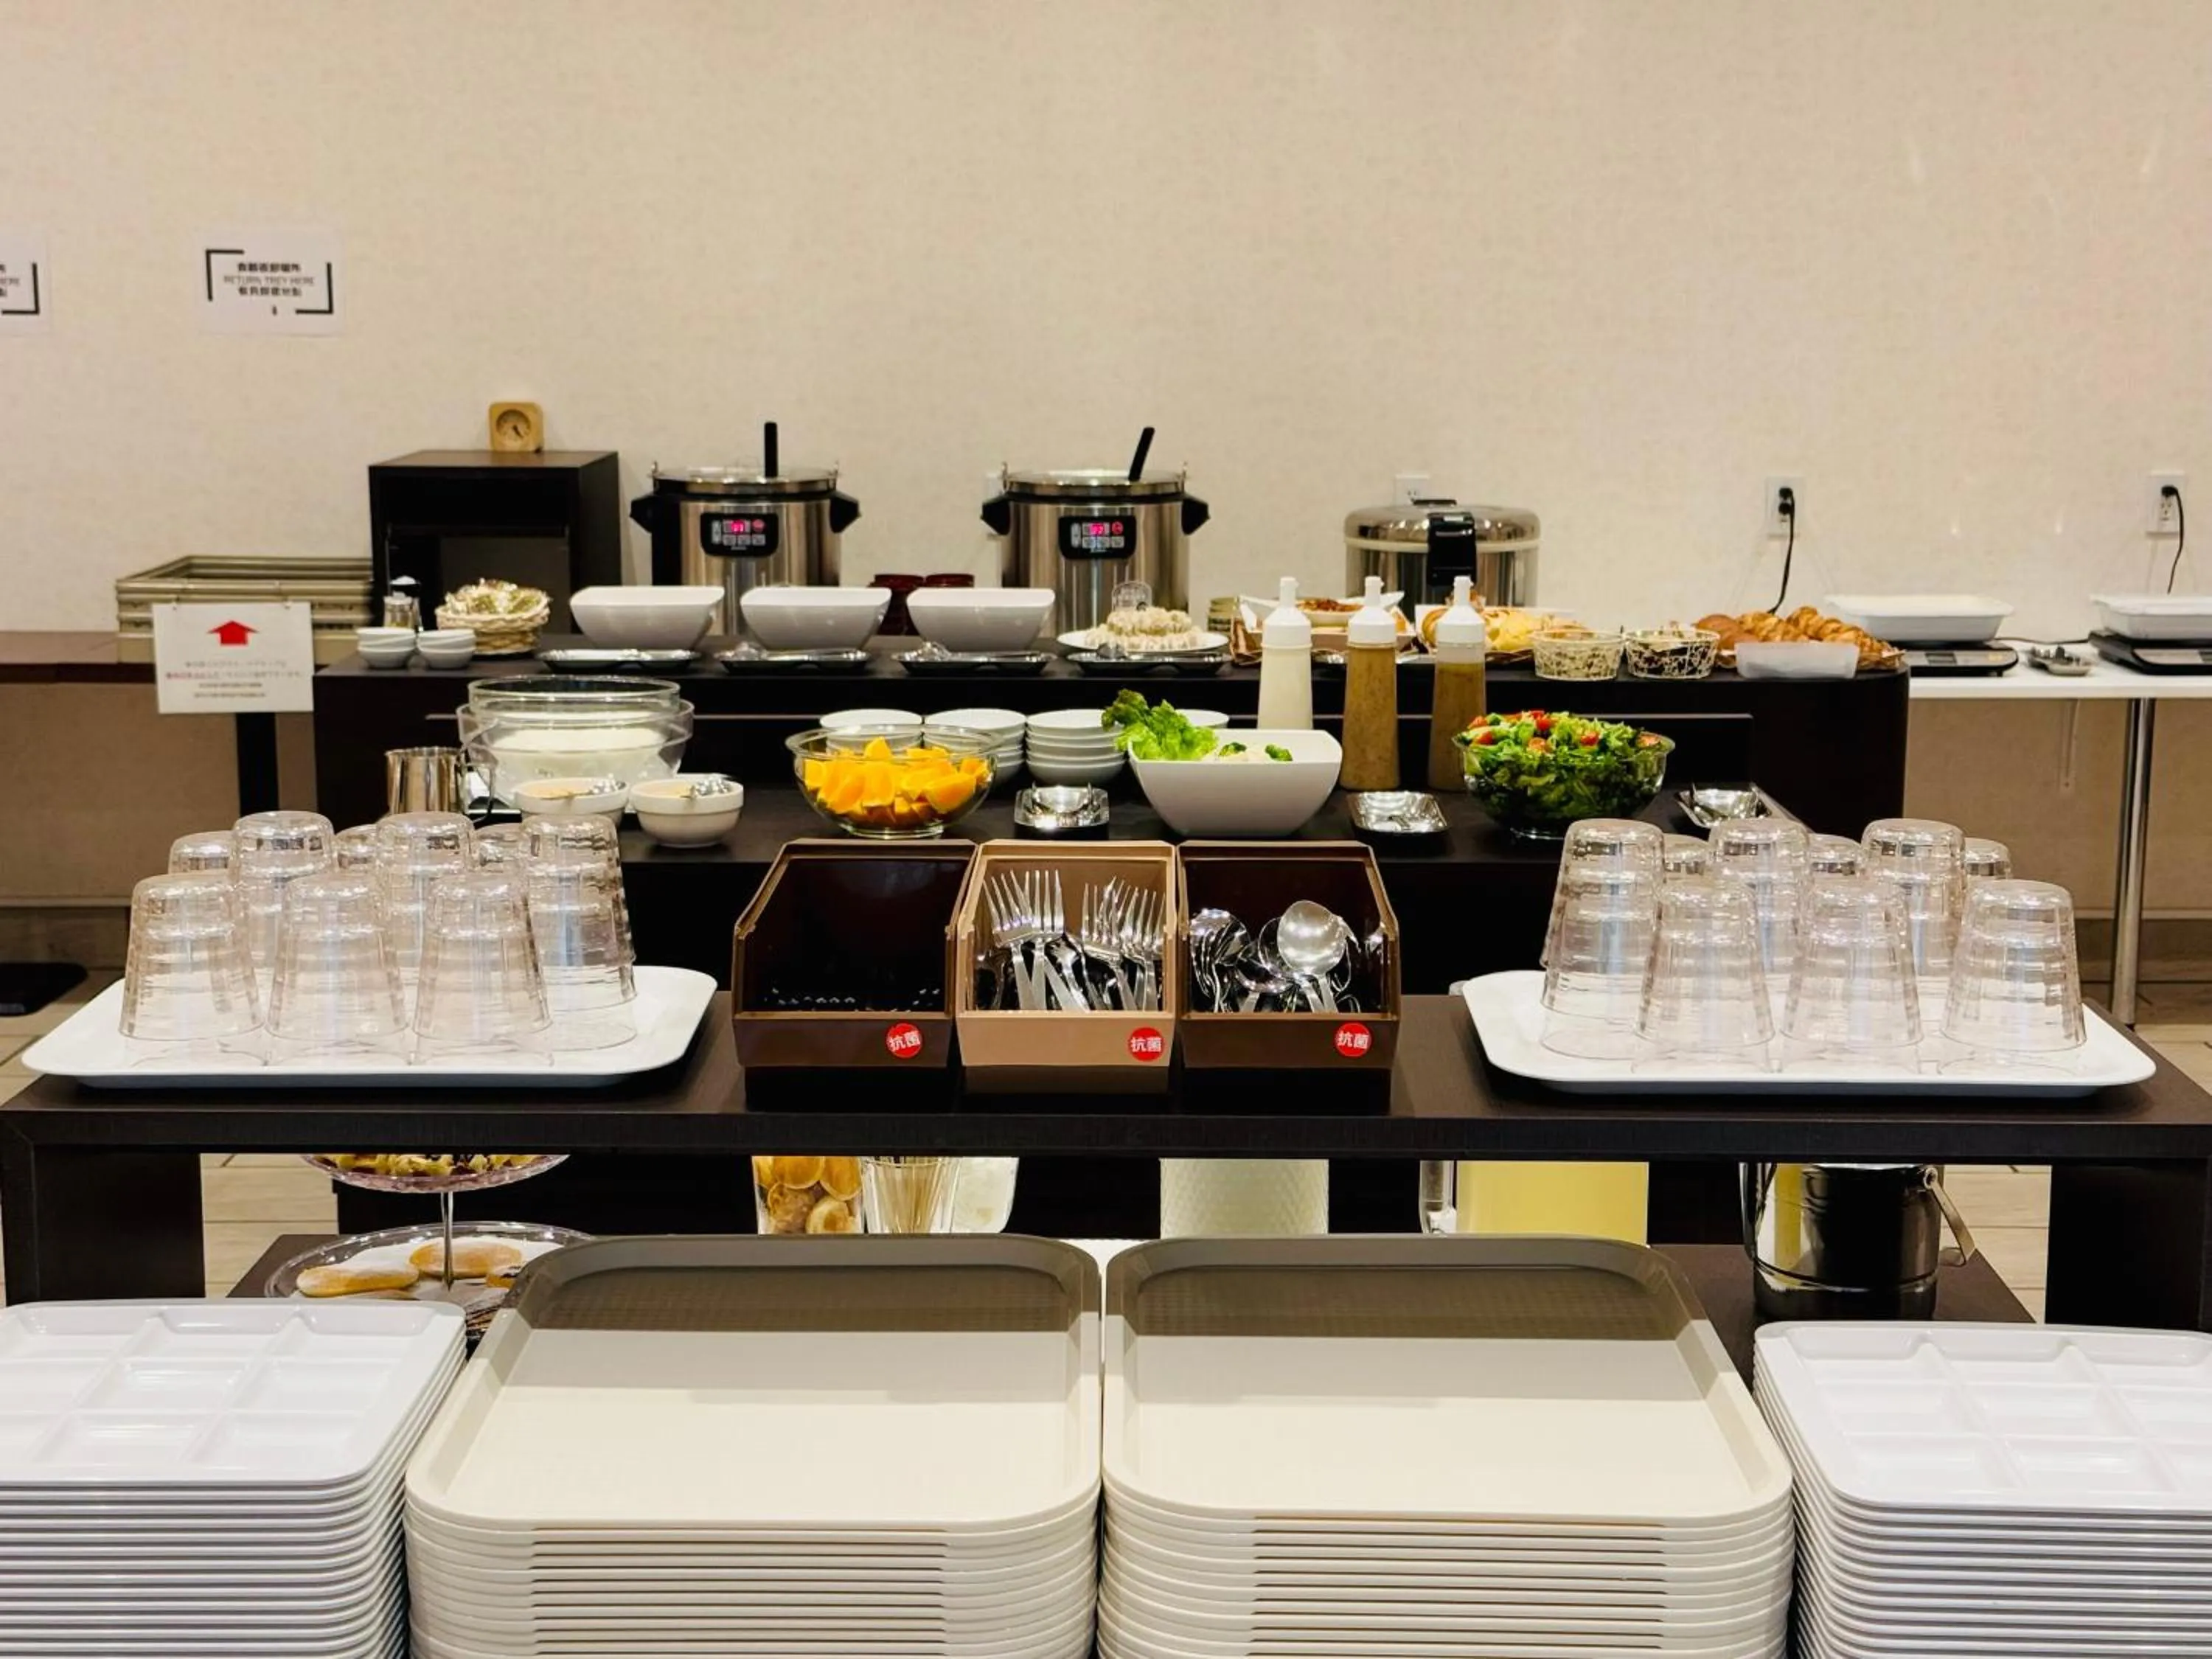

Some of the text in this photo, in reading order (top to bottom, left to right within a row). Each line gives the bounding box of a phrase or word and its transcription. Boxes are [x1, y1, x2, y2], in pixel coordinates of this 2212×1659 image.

[889, 1030, 921, 1052] 抗菌
[1130, 1036, 1162, 1053] 抗菌
[1337, 1030, 1369, 1050] 抗菌
